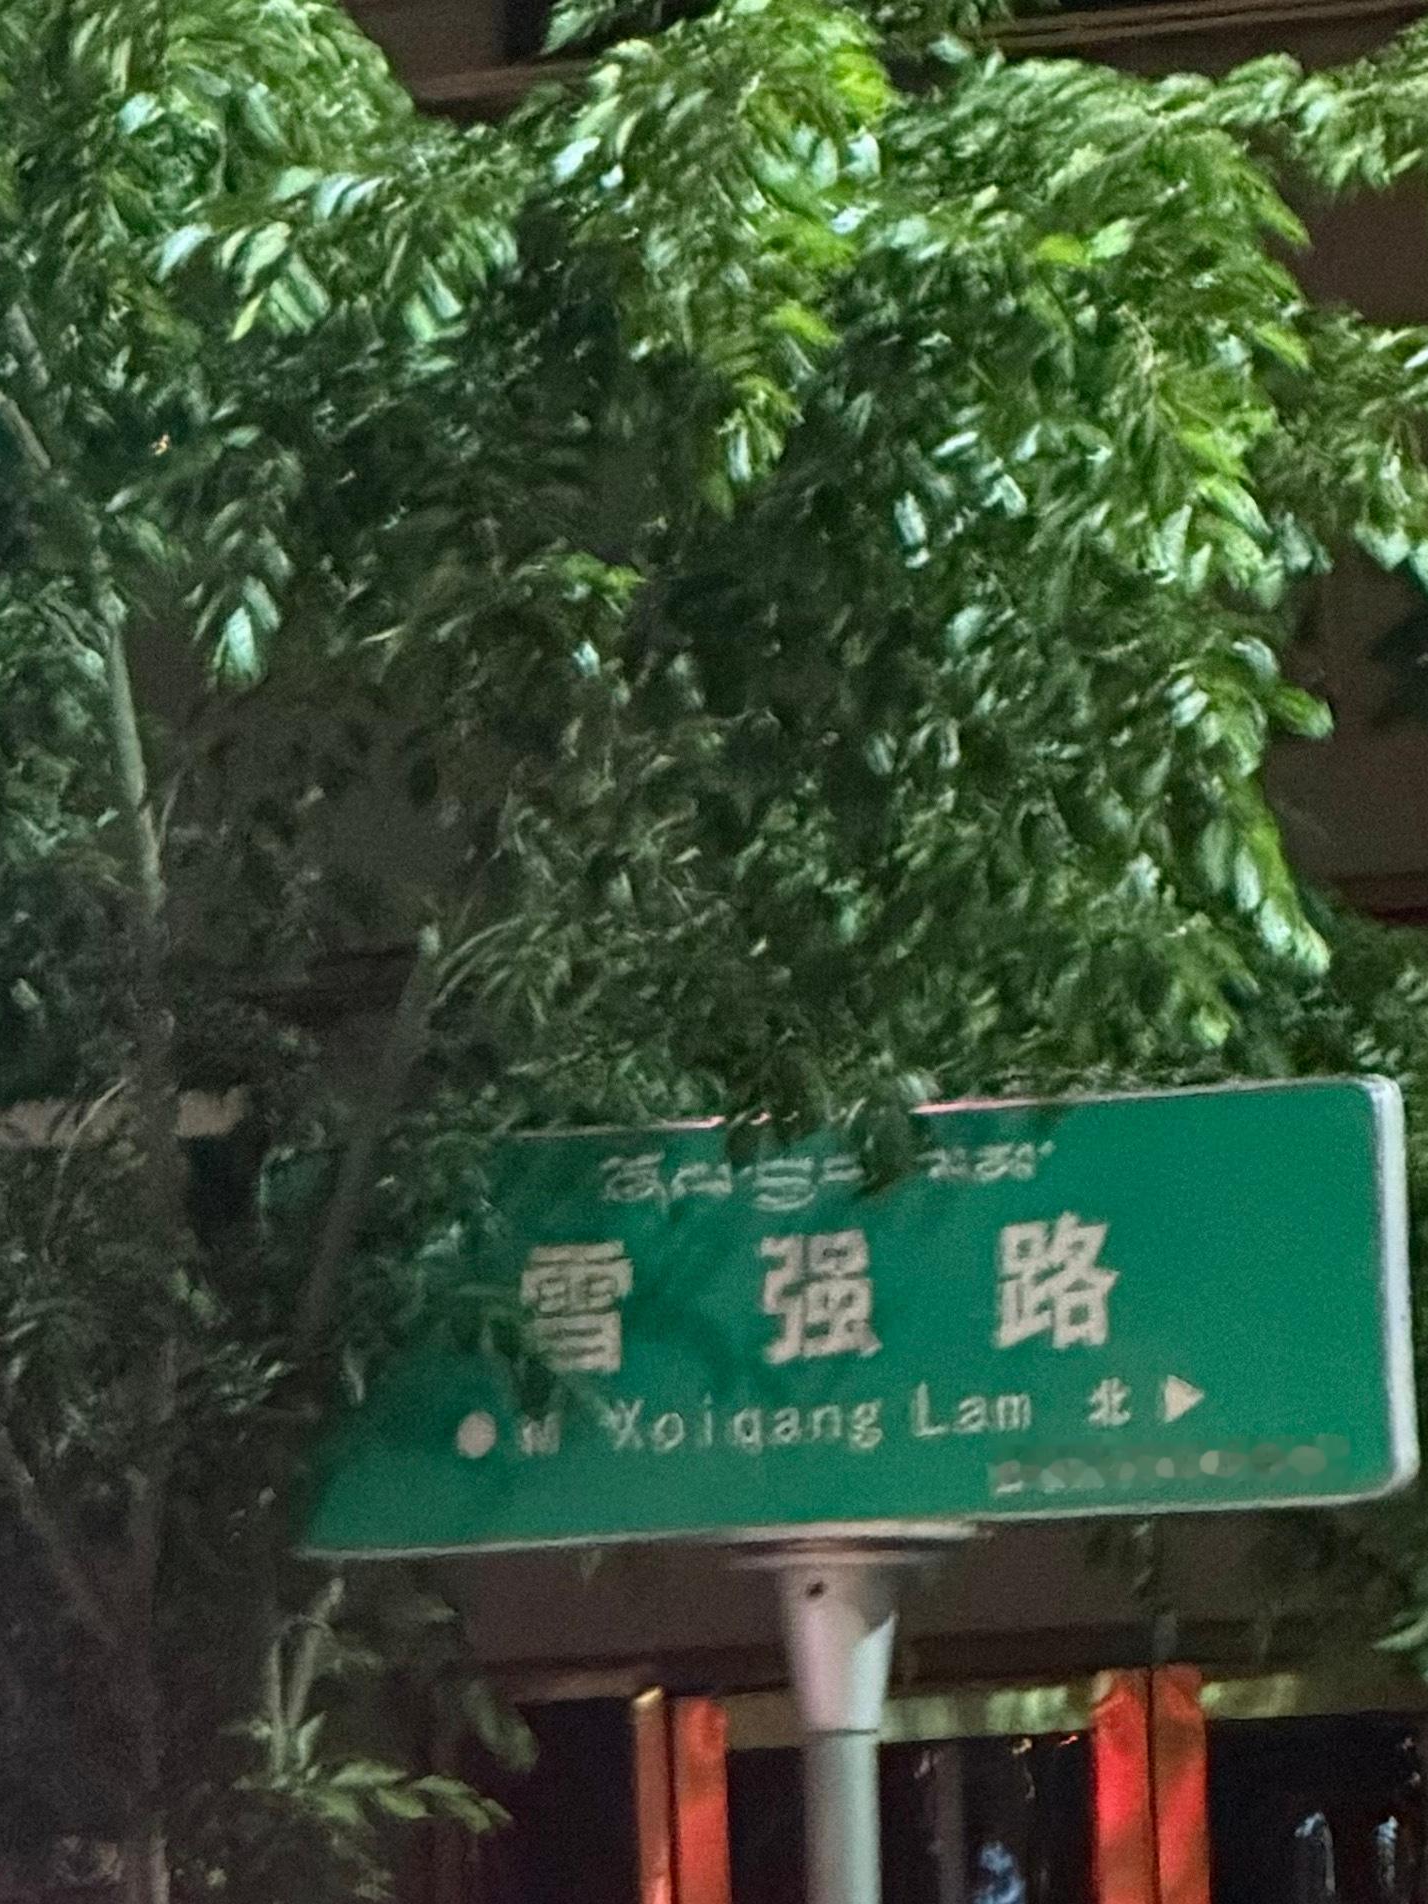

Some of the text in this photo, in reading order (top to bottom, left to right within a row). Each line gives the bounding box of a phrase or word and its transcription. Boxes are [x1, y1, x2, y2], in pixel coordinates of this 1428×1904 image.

[520, 1212, 1120, 1376] 雪强路
[911, 1378, 1031, 1438] Lam
